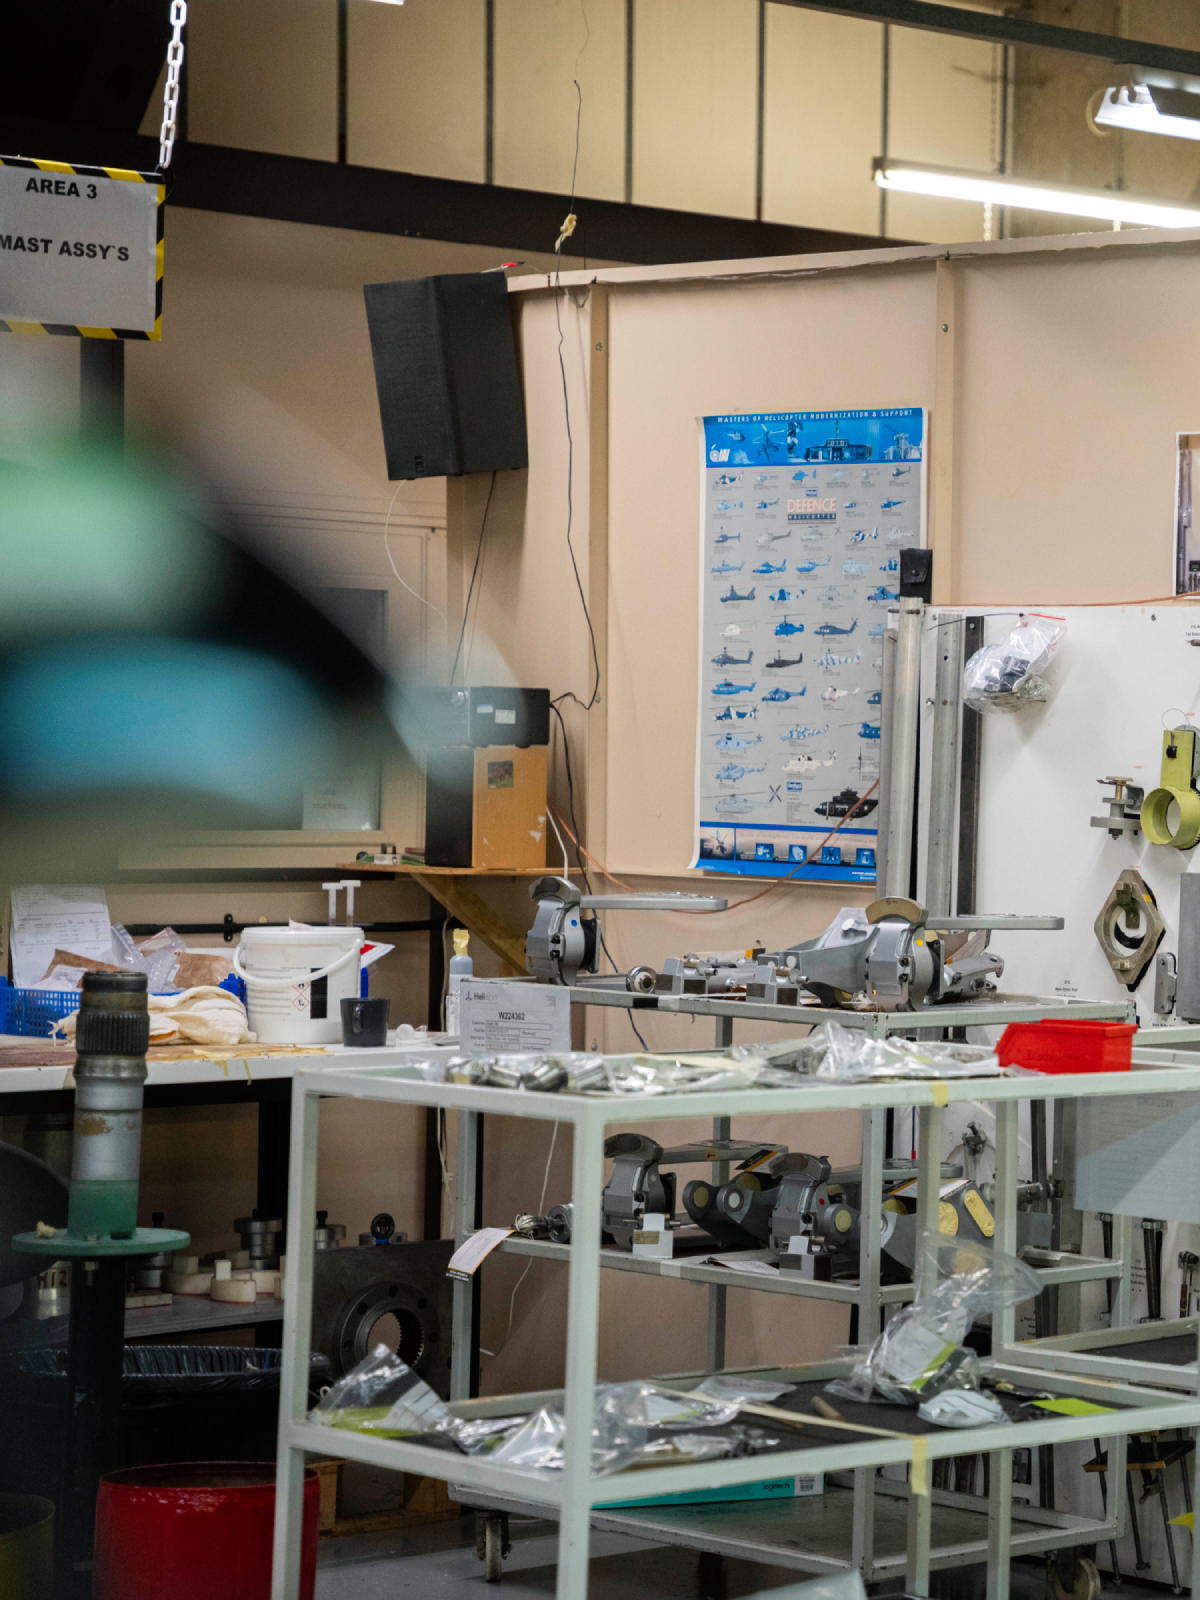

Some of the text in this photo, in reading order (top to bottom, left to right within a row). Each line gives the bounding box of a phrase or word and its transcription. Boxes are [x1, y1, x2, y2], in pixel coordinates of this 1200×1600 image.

[25, 177, 97, 199] AREA 3
[0, 235, 53, 254] MAST
[764, 413, 807, 421] HELICOPTER
[810, 411, 868, 420] MODERNIZATION
[880, 409, 913, 417] SUPPORT
[787, 498, 836, 513] DEFENCE
[498, 1012, 525, 1020] W224362
[763, 1482, 789, 1491] logitech
